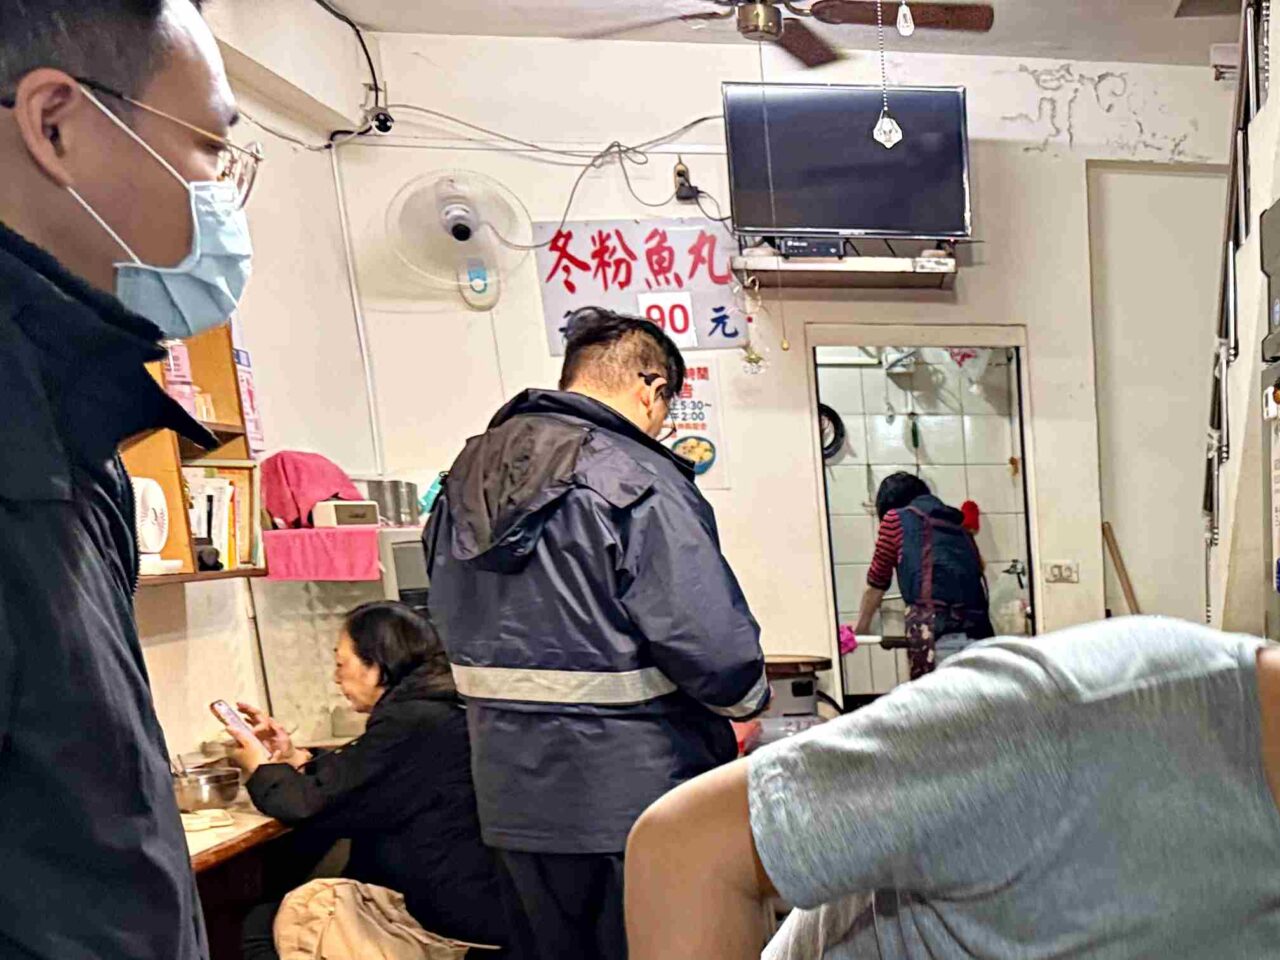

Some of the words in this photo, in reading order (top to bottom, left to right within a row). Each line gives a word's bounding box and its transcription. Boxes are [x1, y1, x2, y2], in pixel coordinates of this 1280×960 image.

[546, 229, 734, 294] 冬粉魚丸
[709, 306, 739, 338] 元
